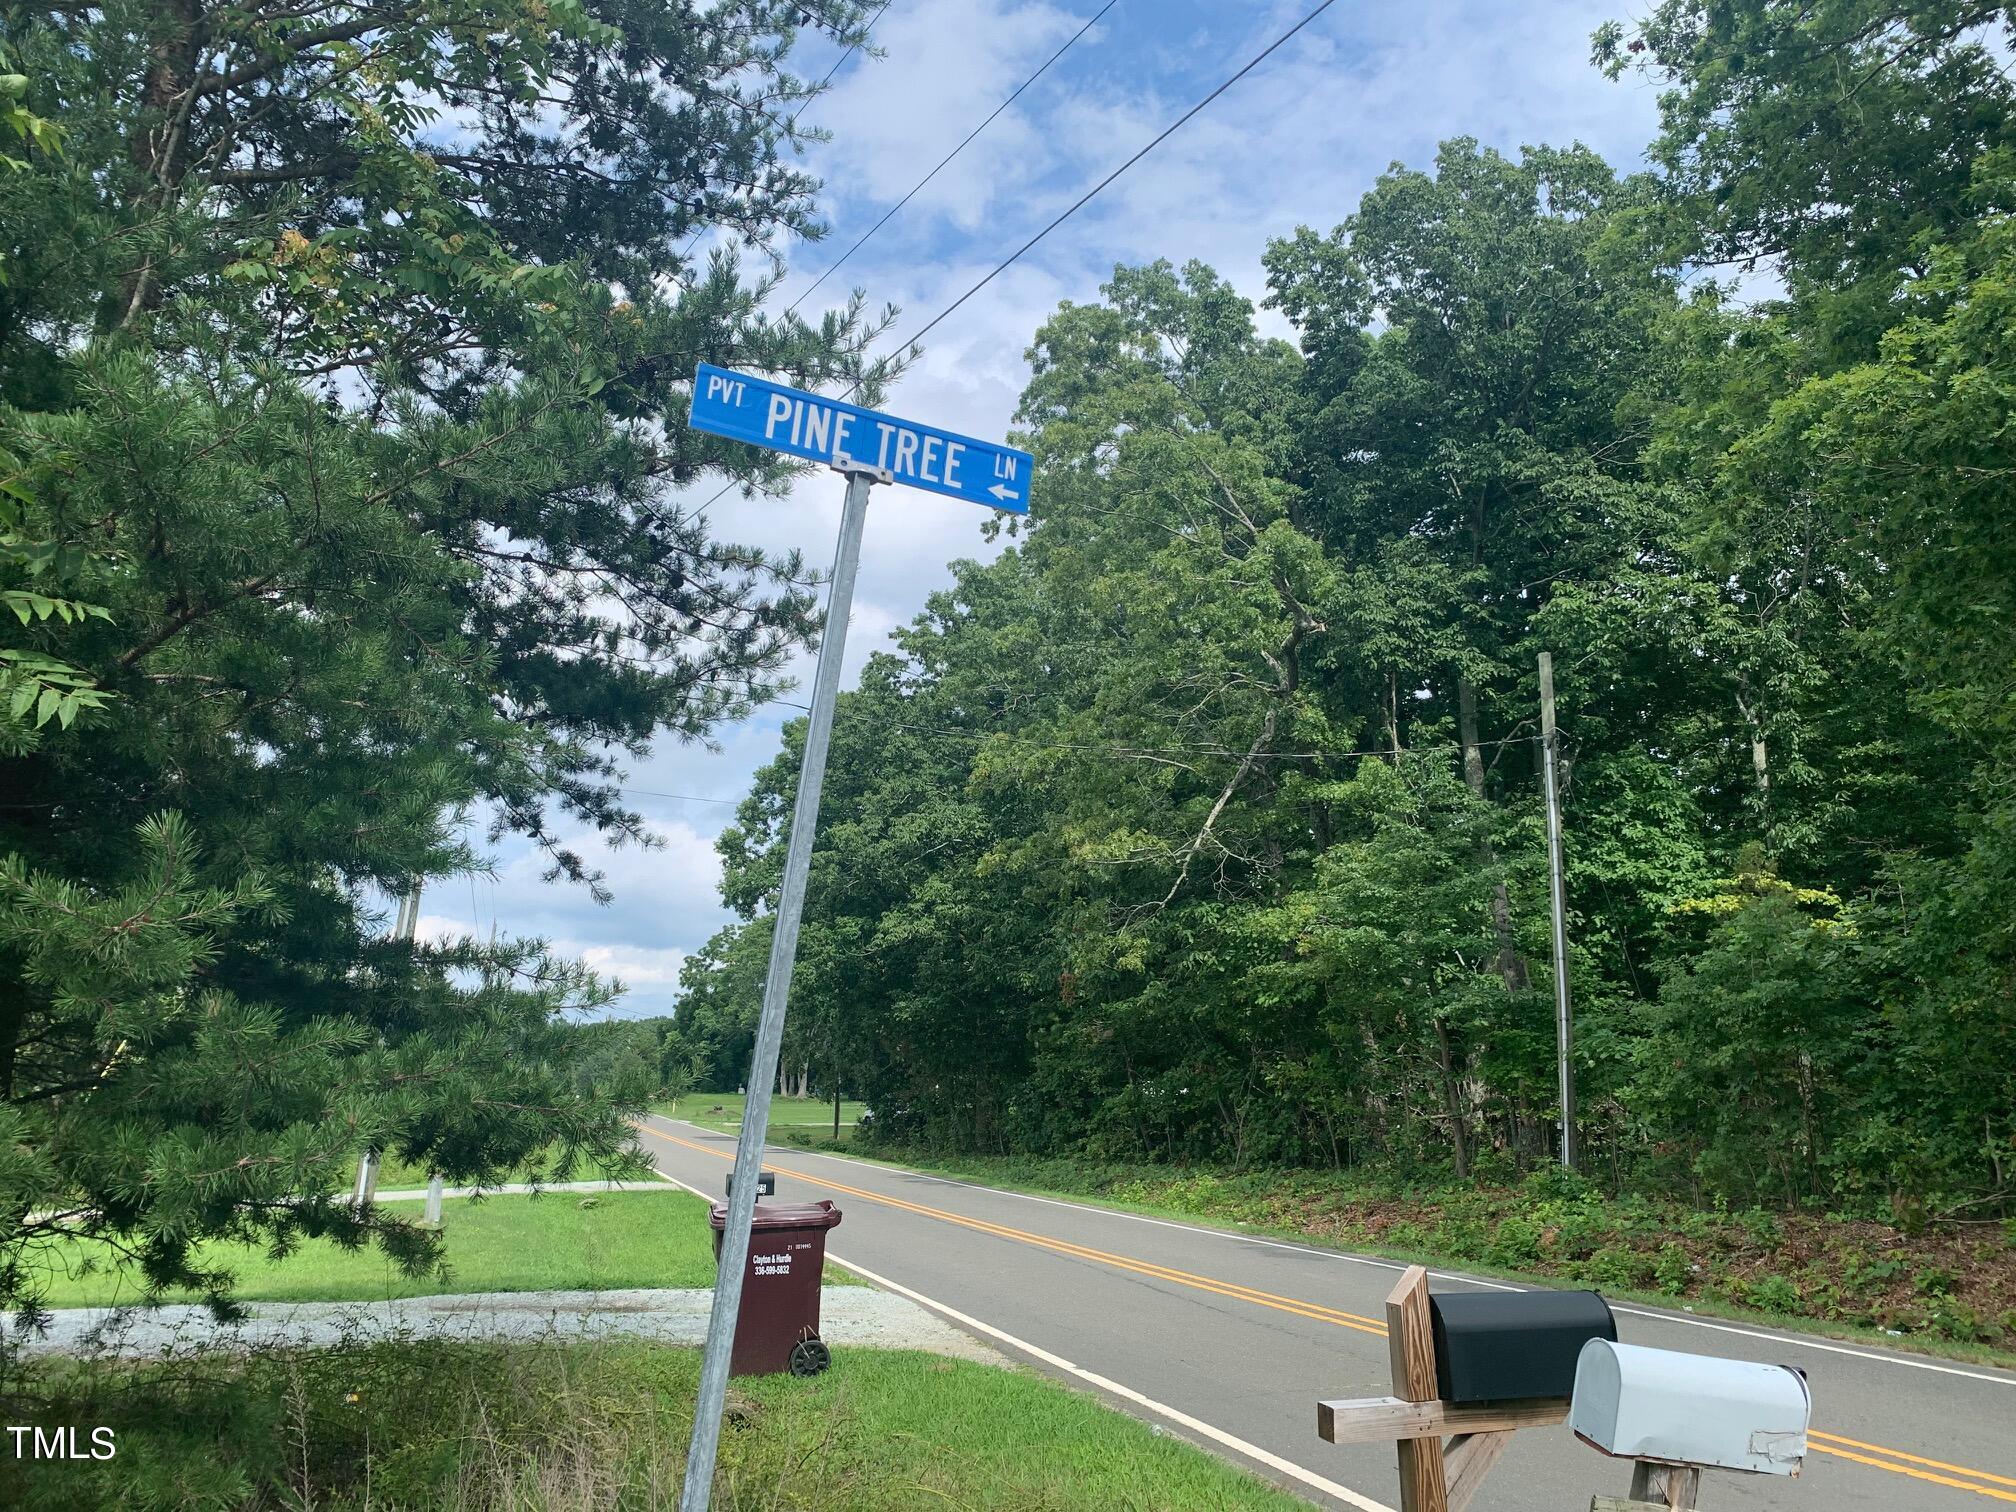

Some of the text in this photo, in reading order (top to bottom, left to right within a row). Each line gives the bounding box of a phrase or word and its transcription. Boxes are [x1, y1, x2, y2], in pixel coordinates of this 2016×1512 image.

[707, 375, 1017, 488] PVT PINE TREE LN
[753, 1255, 771, 1265] Clayton
[771, 1254, 776, 1263] &
